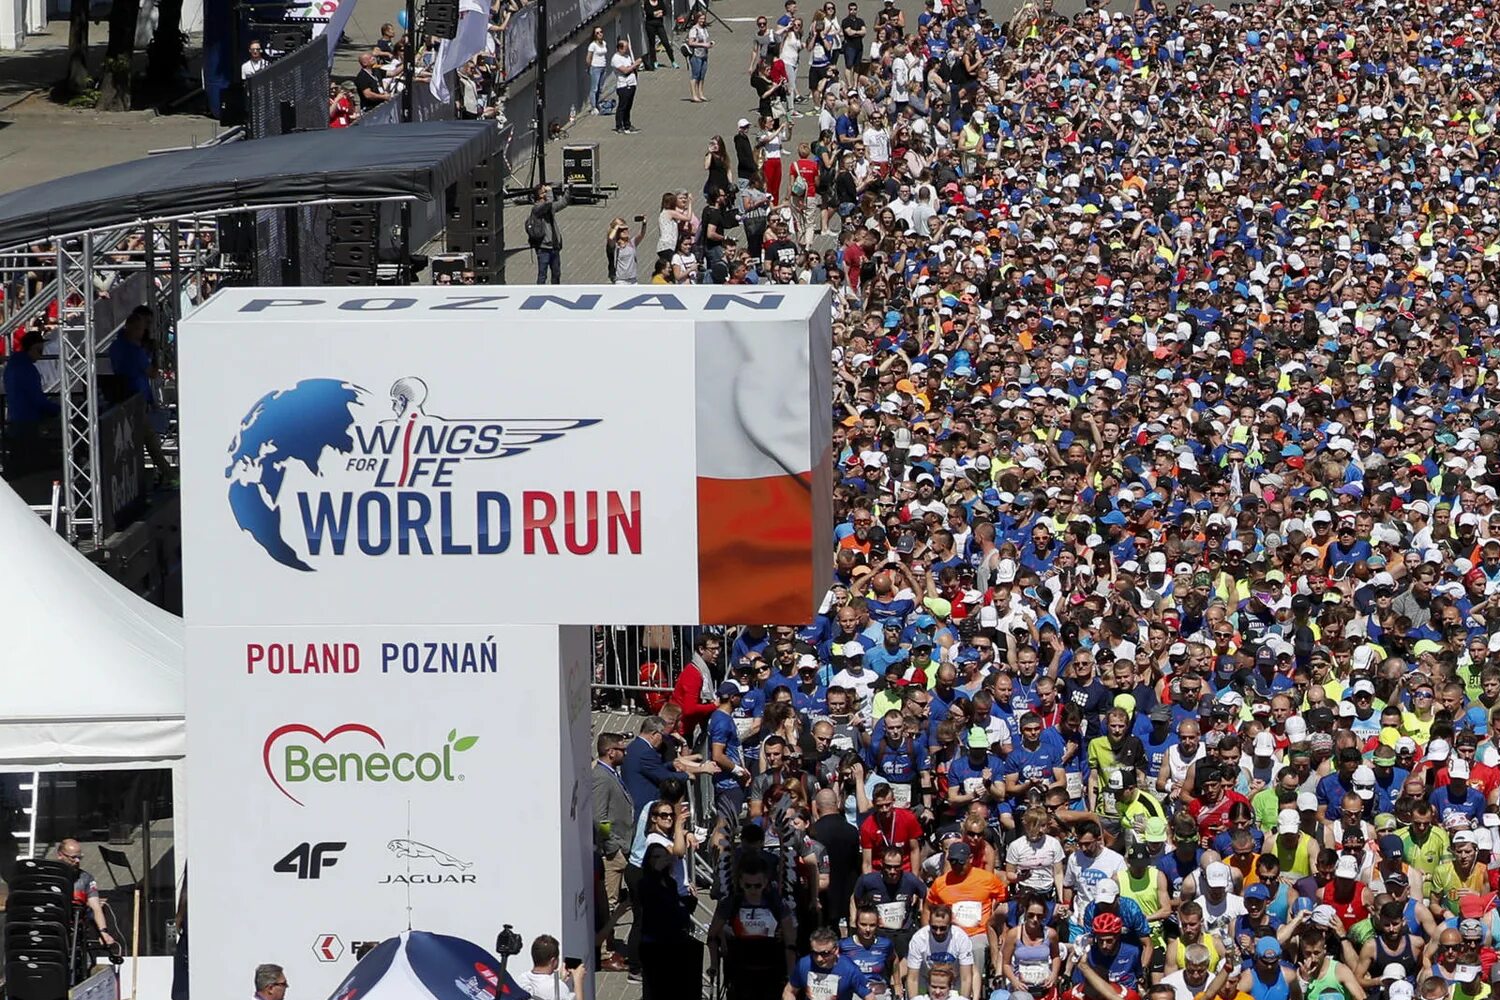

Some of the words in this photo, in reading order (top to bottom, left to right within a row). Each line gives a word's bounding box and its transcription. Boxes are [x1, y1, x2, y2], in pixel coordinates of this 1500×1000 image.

[237, 290, 787, 312] POZNAŃ
[354, 413, 502, 454] WINGS
[345, 458, 378, 472] FOR
[375, 457, 461, 487] LIFE
[296, 490, 511, 555] WORLD
[523, 490, 643, 555] RUN
[246, 643, 360, 674] POLAND
[381, 635, 498, 673] POZNAŃ
[284, 744, 456, 782] Benecol
[273, 841, 348, 879] 4F
[378, 874, 476, 884] JAGUAR
